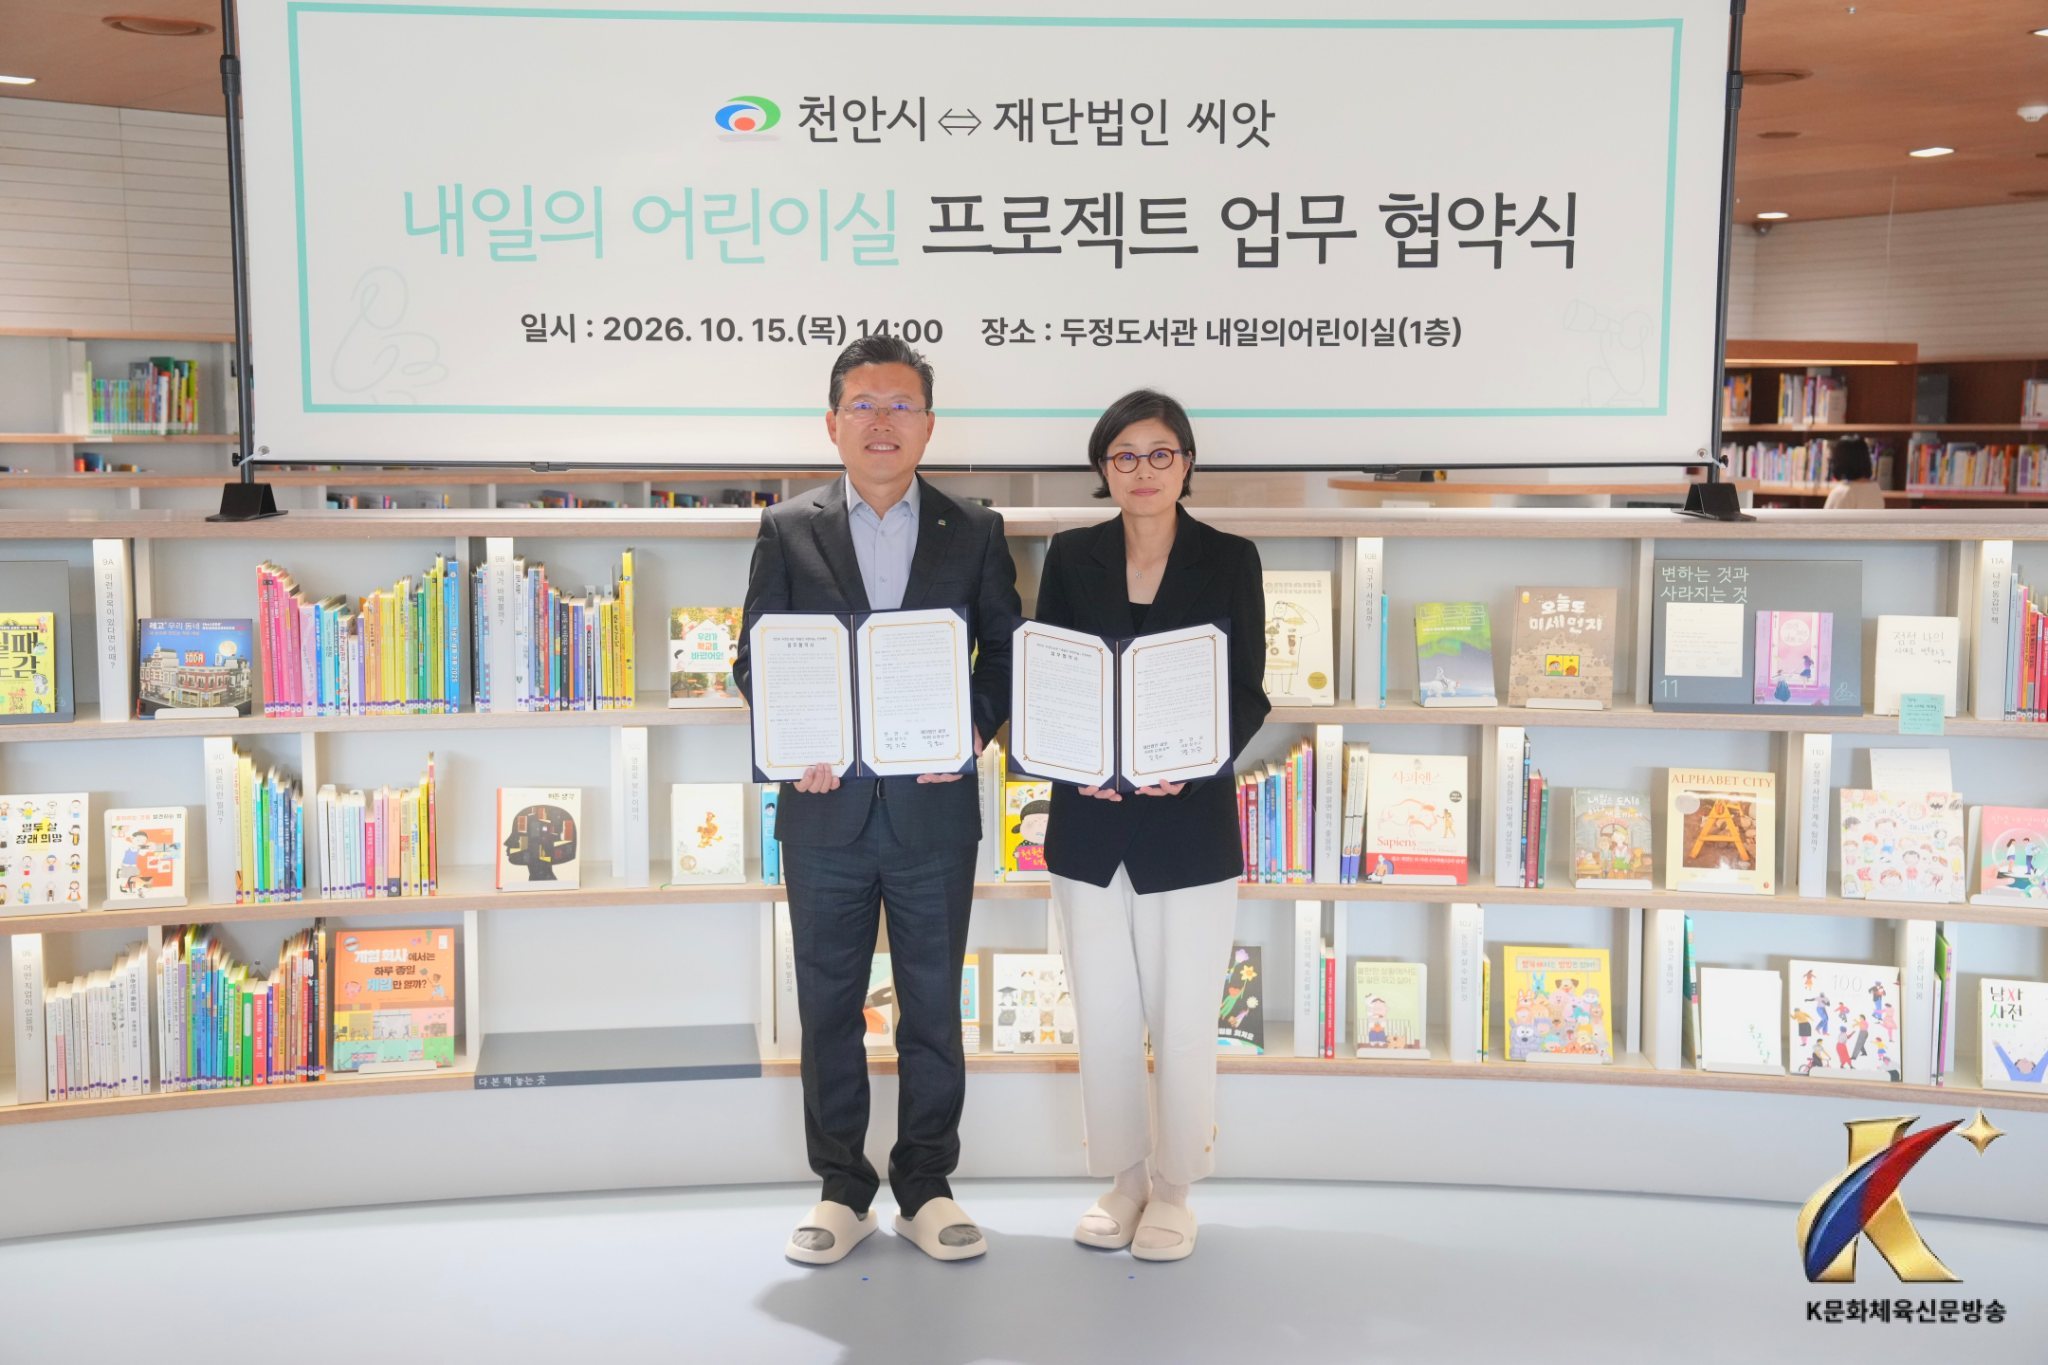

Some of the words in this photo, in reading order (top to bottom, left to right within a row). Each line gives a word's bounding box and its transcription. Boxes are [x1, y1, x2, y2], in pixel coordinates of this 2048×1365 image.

[798, 95, 928, 143] 천안시
[993, 97, 1168, 146] 재단법인
[1187, 99, 1275, 149] 씨앗
[404, 183, 602, 261] 내일의
[633, 187, 899, 266] 어린이실
[922, 191, 1199, 269] 프로젝트
[1221, 192, 1357, 268] 업무
[1378, 192, 1576, 269] 협약식
[521, 313, 576, 343] 일시
[603, 316, 692, 342] 2026.
[700, 317, 744, 343] 10.
[751, 314, 847, 347] 15.(목)
[856, 318, 944, 343] 14:00
[981, 317, 1036, 346] 장소
[1061, 317, 1198, 347] 두정도서관
[1206, 316, 1462, 348] 내일의어린이실(1층)
[1661, 565, 1711, 583] 변하는
[1716, 566, 1749, 584] 것과
[1541, 593, 1585, 615] 오늘도
[1660, 585, 1727, 603] 사라지는
[1733, 586, 1748, 604] 것
[1660, 679, 1678, 698] 11
[1671, 774, 1740, 786] ALPHABET
[1743, 776, 1774, 788] CITY
[16, 834, 38, 845] 장래
[1376, 835, 1417, 849] Sapiens
[374, 966, 394, 976] 하루
[1831, 974, 1863, 991] 100
[1990, 986, 2024, 1002] 남자
[1990, 1003, 2023, 1023] 사전
[479, 1078, 488, 1087] 다
[490, 1077, 500, 1087] 본
[503, 1076, 512, 1087] 책
